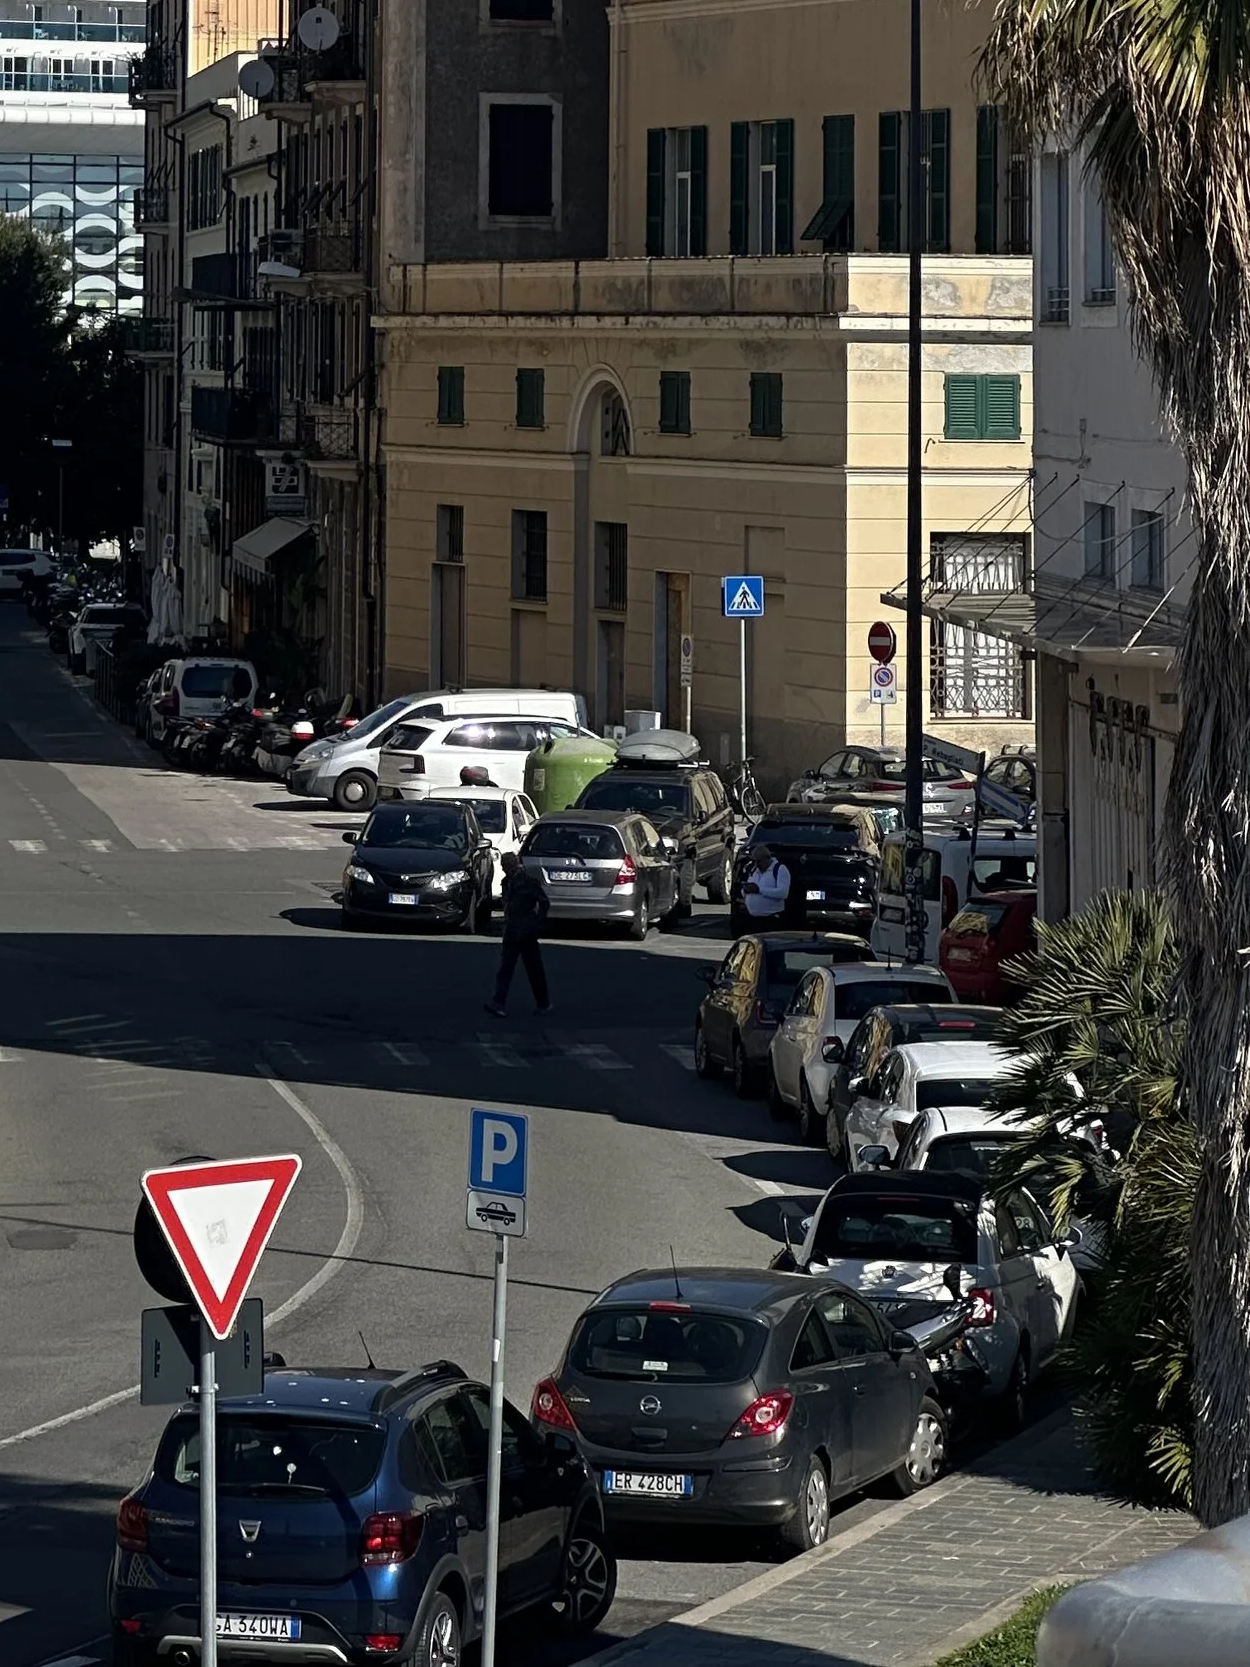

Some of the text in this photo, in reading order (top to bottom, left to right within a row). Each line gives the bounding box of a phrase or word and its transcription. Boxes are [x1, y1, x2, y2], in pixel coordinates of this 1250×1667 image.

[481, 1118, 518, 1183] P
[615, 1472, 683, 1492] ER 428CH
[238, 1614, 289, 1636] 340WA
